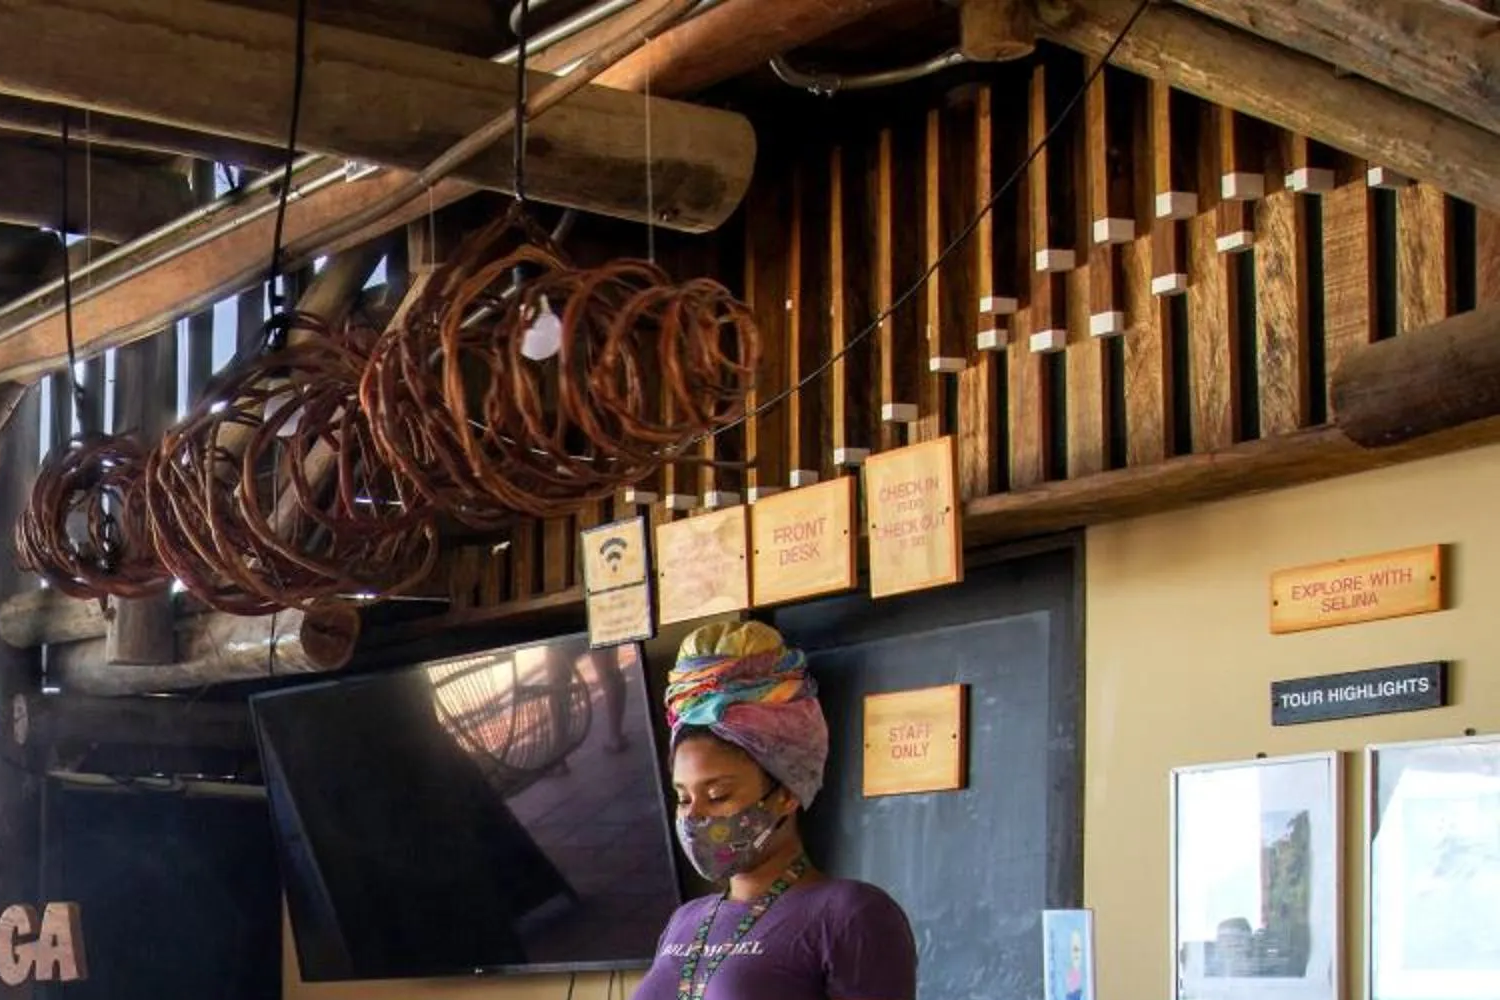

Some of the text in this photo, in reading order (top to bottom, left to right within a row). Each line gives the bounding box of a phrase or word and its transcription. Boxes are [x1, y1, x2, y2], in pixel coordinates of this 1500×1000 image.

[879, 480, 923, 503] CHECK
[772, 516, 827, 544] FRONT
[779, 542, 821, 567] DESK
[1291, 567, 1413, 600] EXPLORE WITH
[1321, 591, 1379, 613] SELINA
[1281, 676, 1430, 709] TOUR HIGHLIGHTS
[888, 721, 933, 743] STAFF
[891, 741, 930, 759] ONLY
